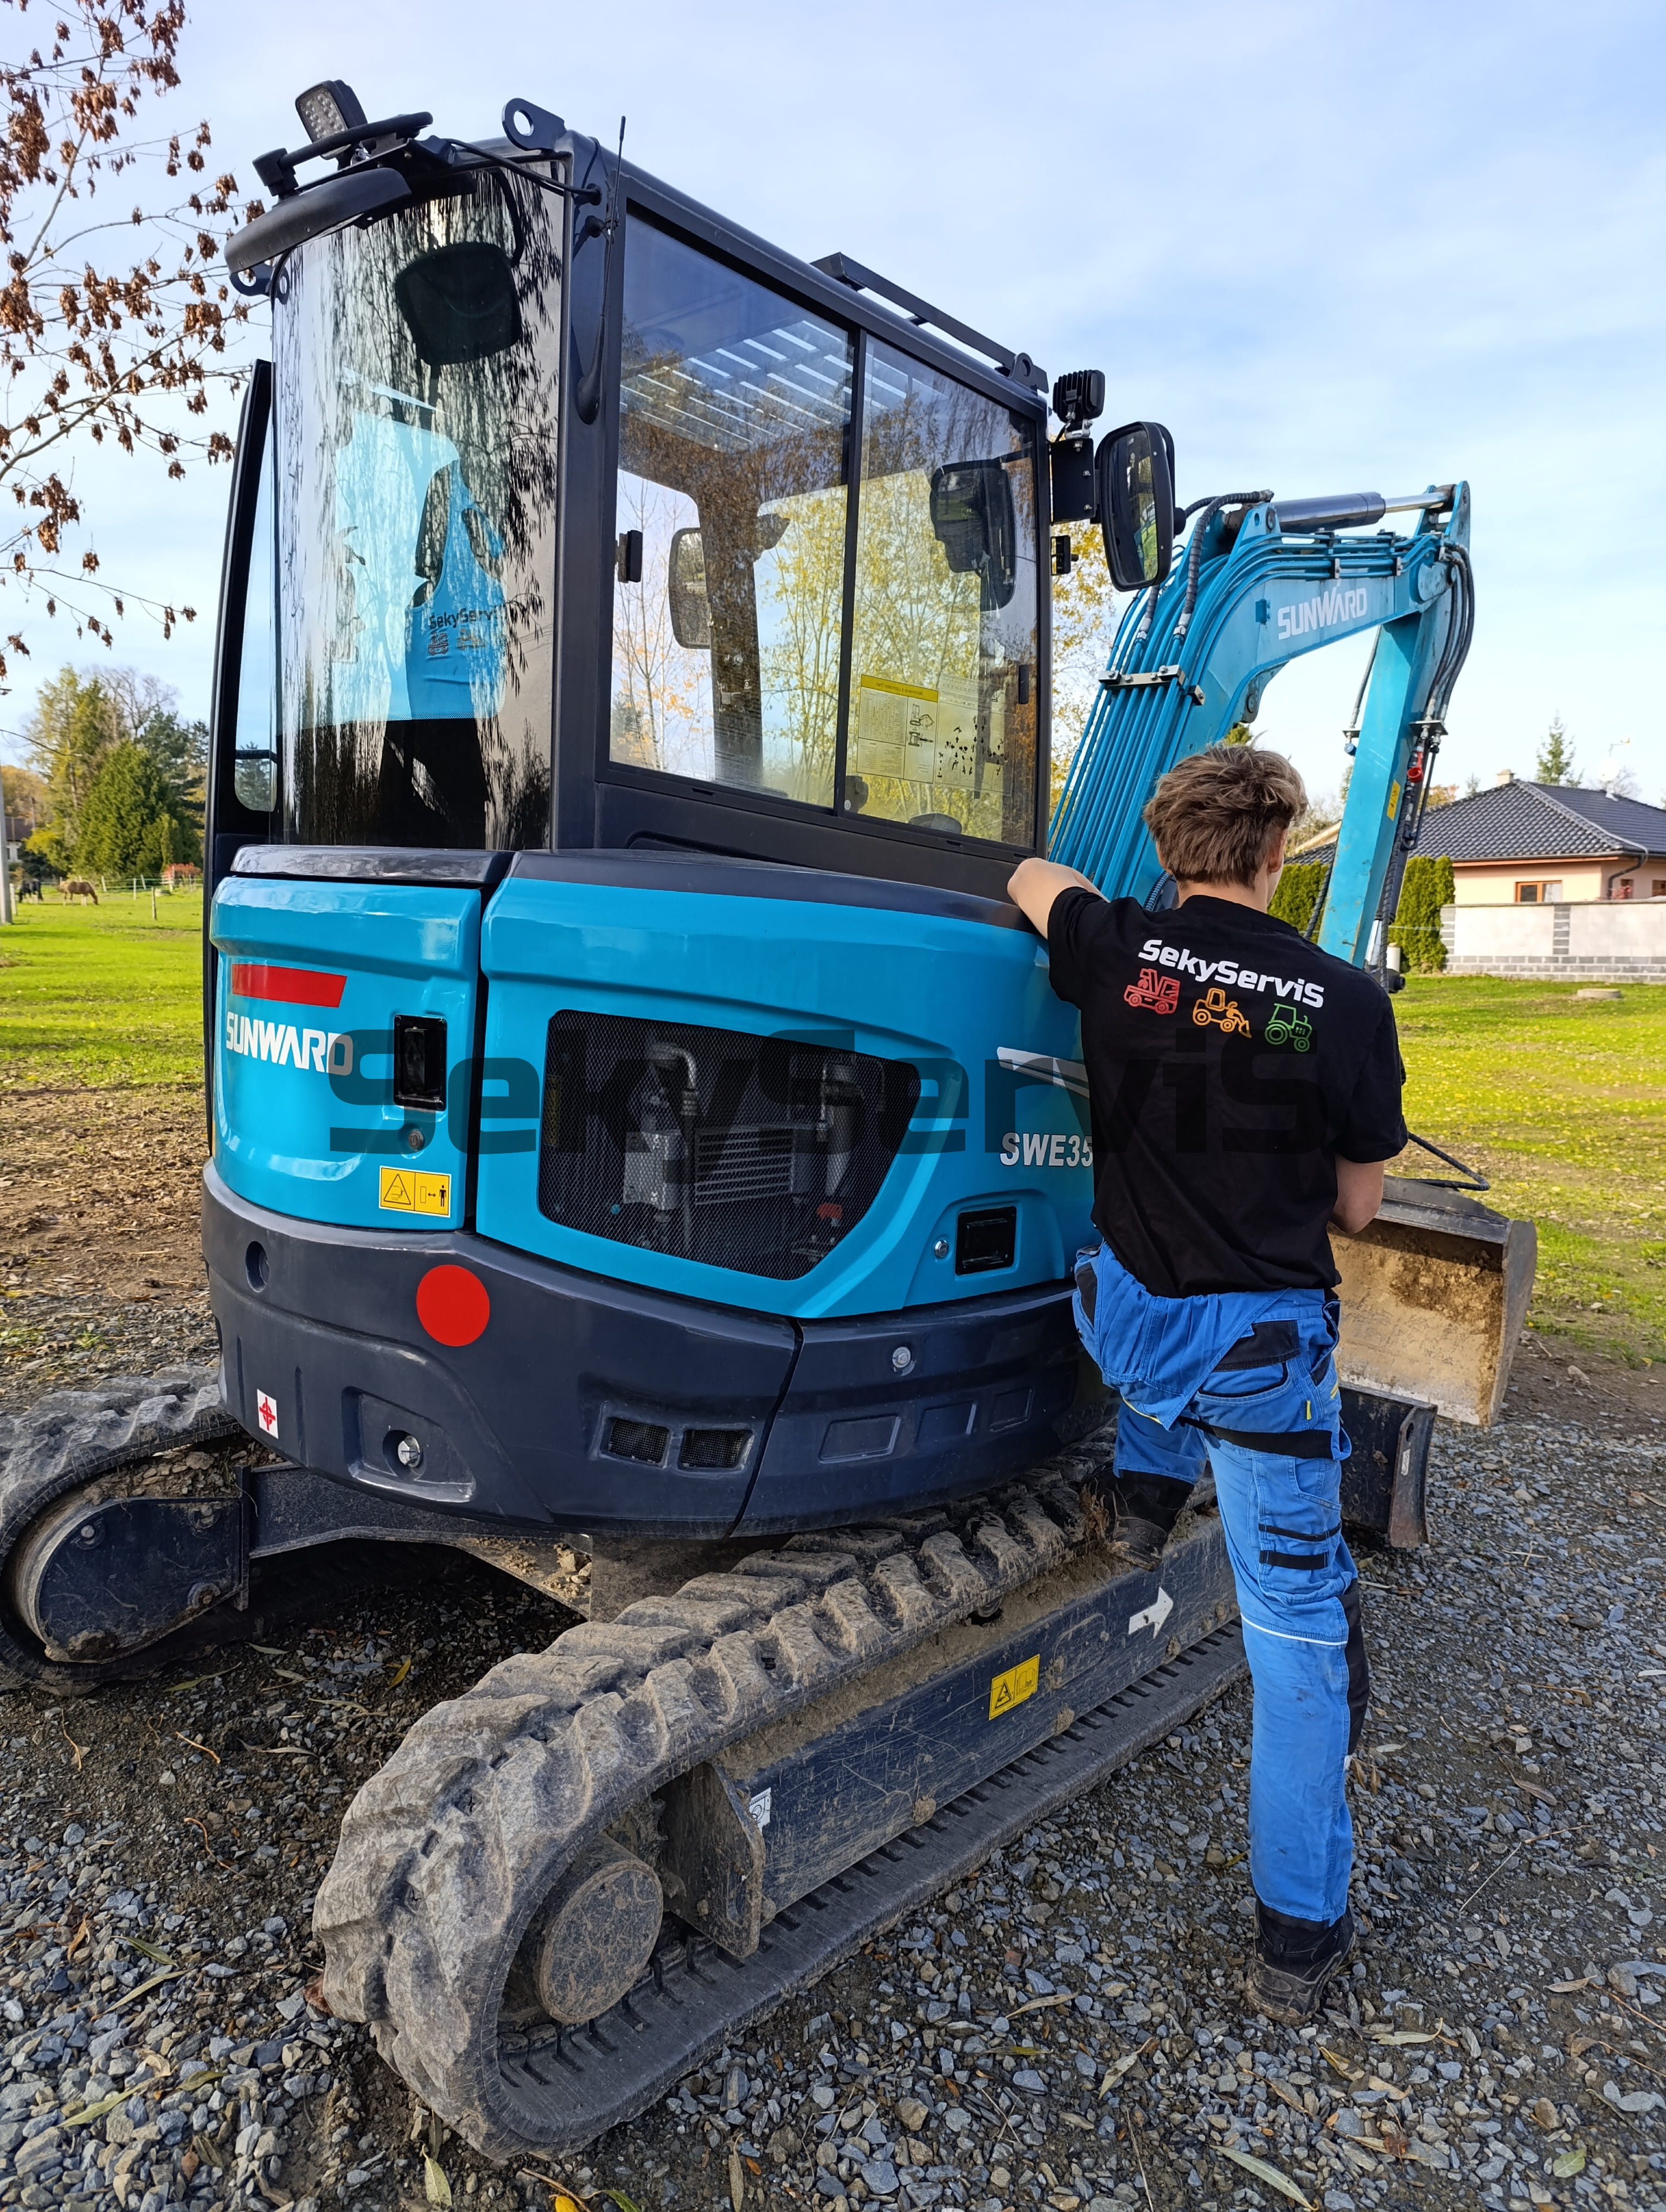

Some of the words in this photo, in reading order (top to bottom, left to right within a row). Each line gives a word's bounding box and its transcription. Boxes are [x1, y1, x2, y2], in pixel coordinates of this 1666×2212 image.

[1278, 579, 1368, 640] SUNWARD
[226, 1012, 353, 1076] SUNWARD
[999, 1132, 1093, 1167] SWE35
